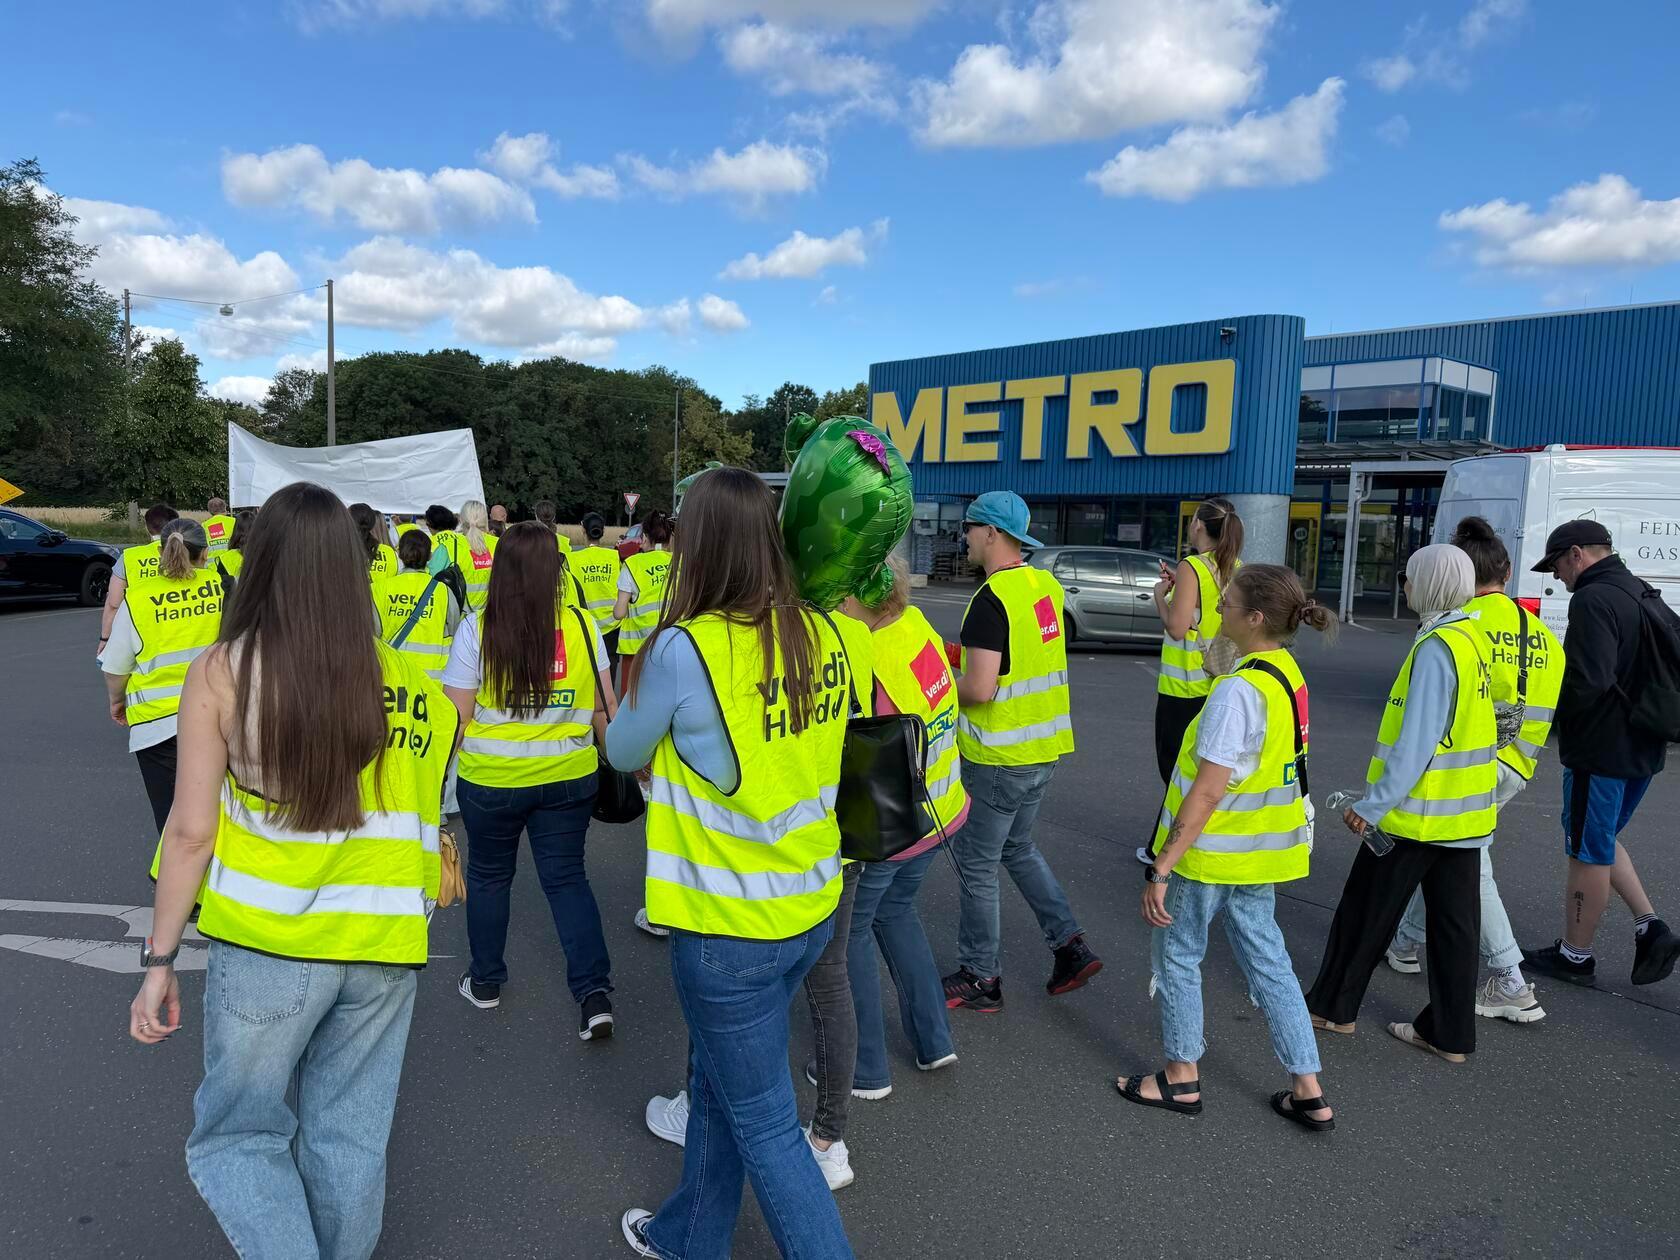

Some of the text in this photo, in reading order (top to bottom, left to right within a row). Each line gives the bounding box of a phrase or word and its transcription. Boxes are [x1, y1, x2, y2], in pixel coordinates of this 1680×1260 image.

[872, 358, 1237, 464] METRO
[149, 580, 222, 607] ver.di
[388, 593, 434, 606] ver.i
[155, 598, 222, 623] Handel
[387, 606, 434, 619] Hanel
[1485, 630, 1549, 652] verdi
[925, 669, 949, 698] ver.di
